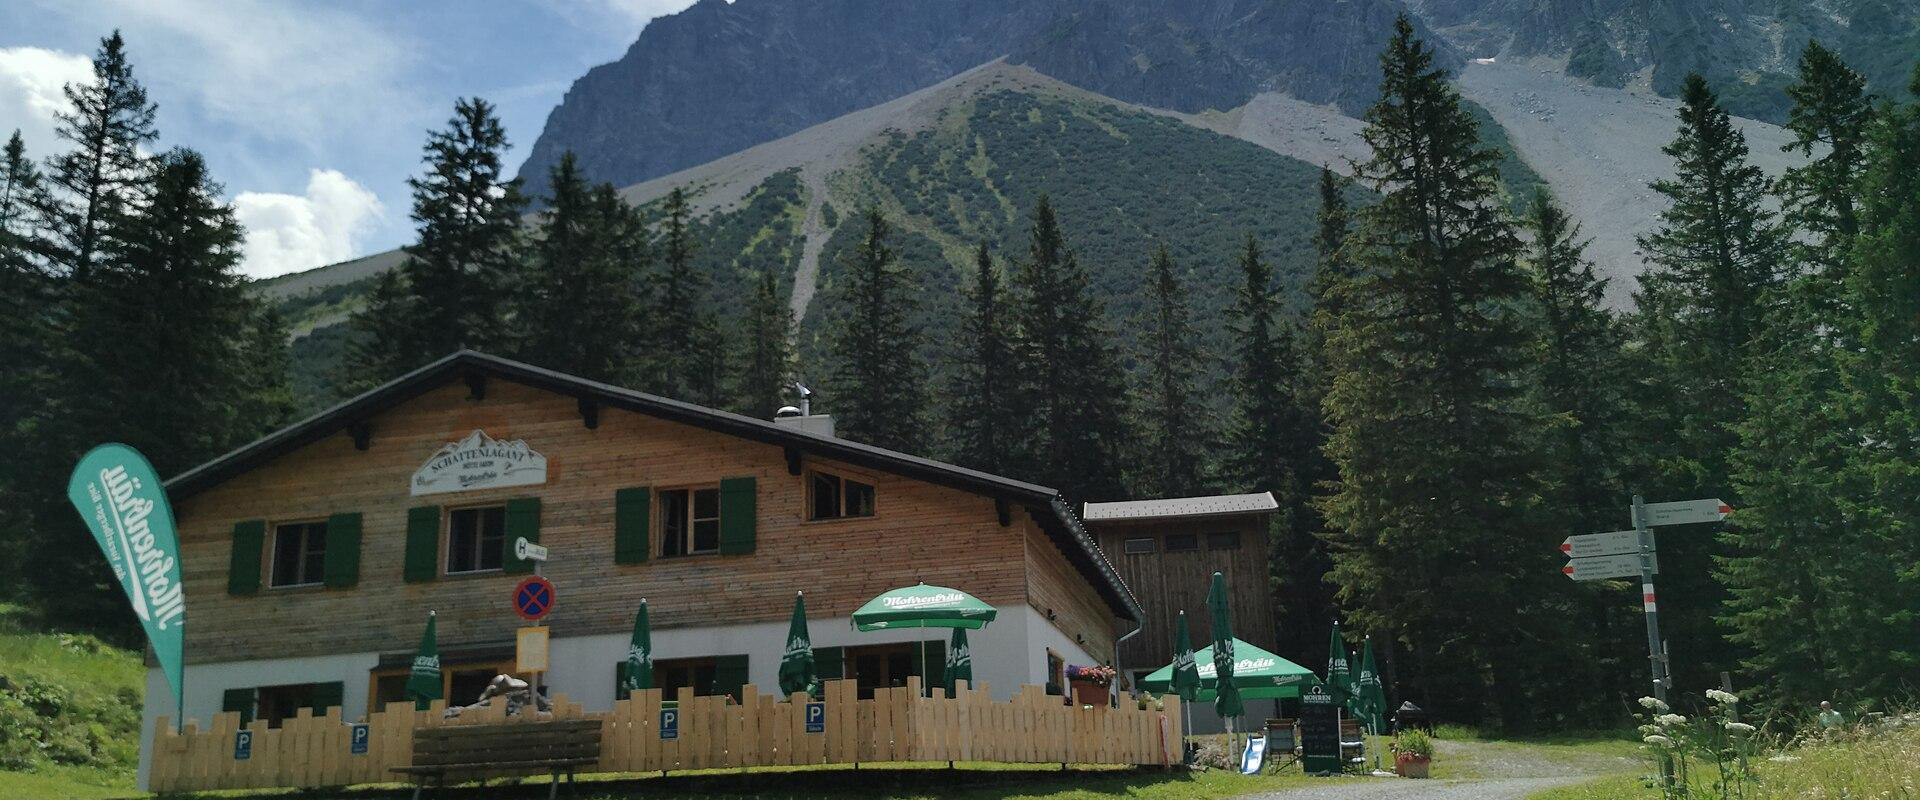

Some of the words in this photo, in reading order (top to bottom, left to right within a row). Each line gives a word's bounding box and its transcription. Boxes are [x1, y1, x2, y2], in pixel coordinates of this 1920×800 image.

[431, 448, 525, 473] SCHATTENLAGANT
[518, 541, 527, 554] H
[882, 593, 965, 607] Mohrenbräu
[664, 712, 675, 728] P
[810, 706, 822, 722] P
[239, 733, 250, 749] P
[355, 727, 367, 743] P
